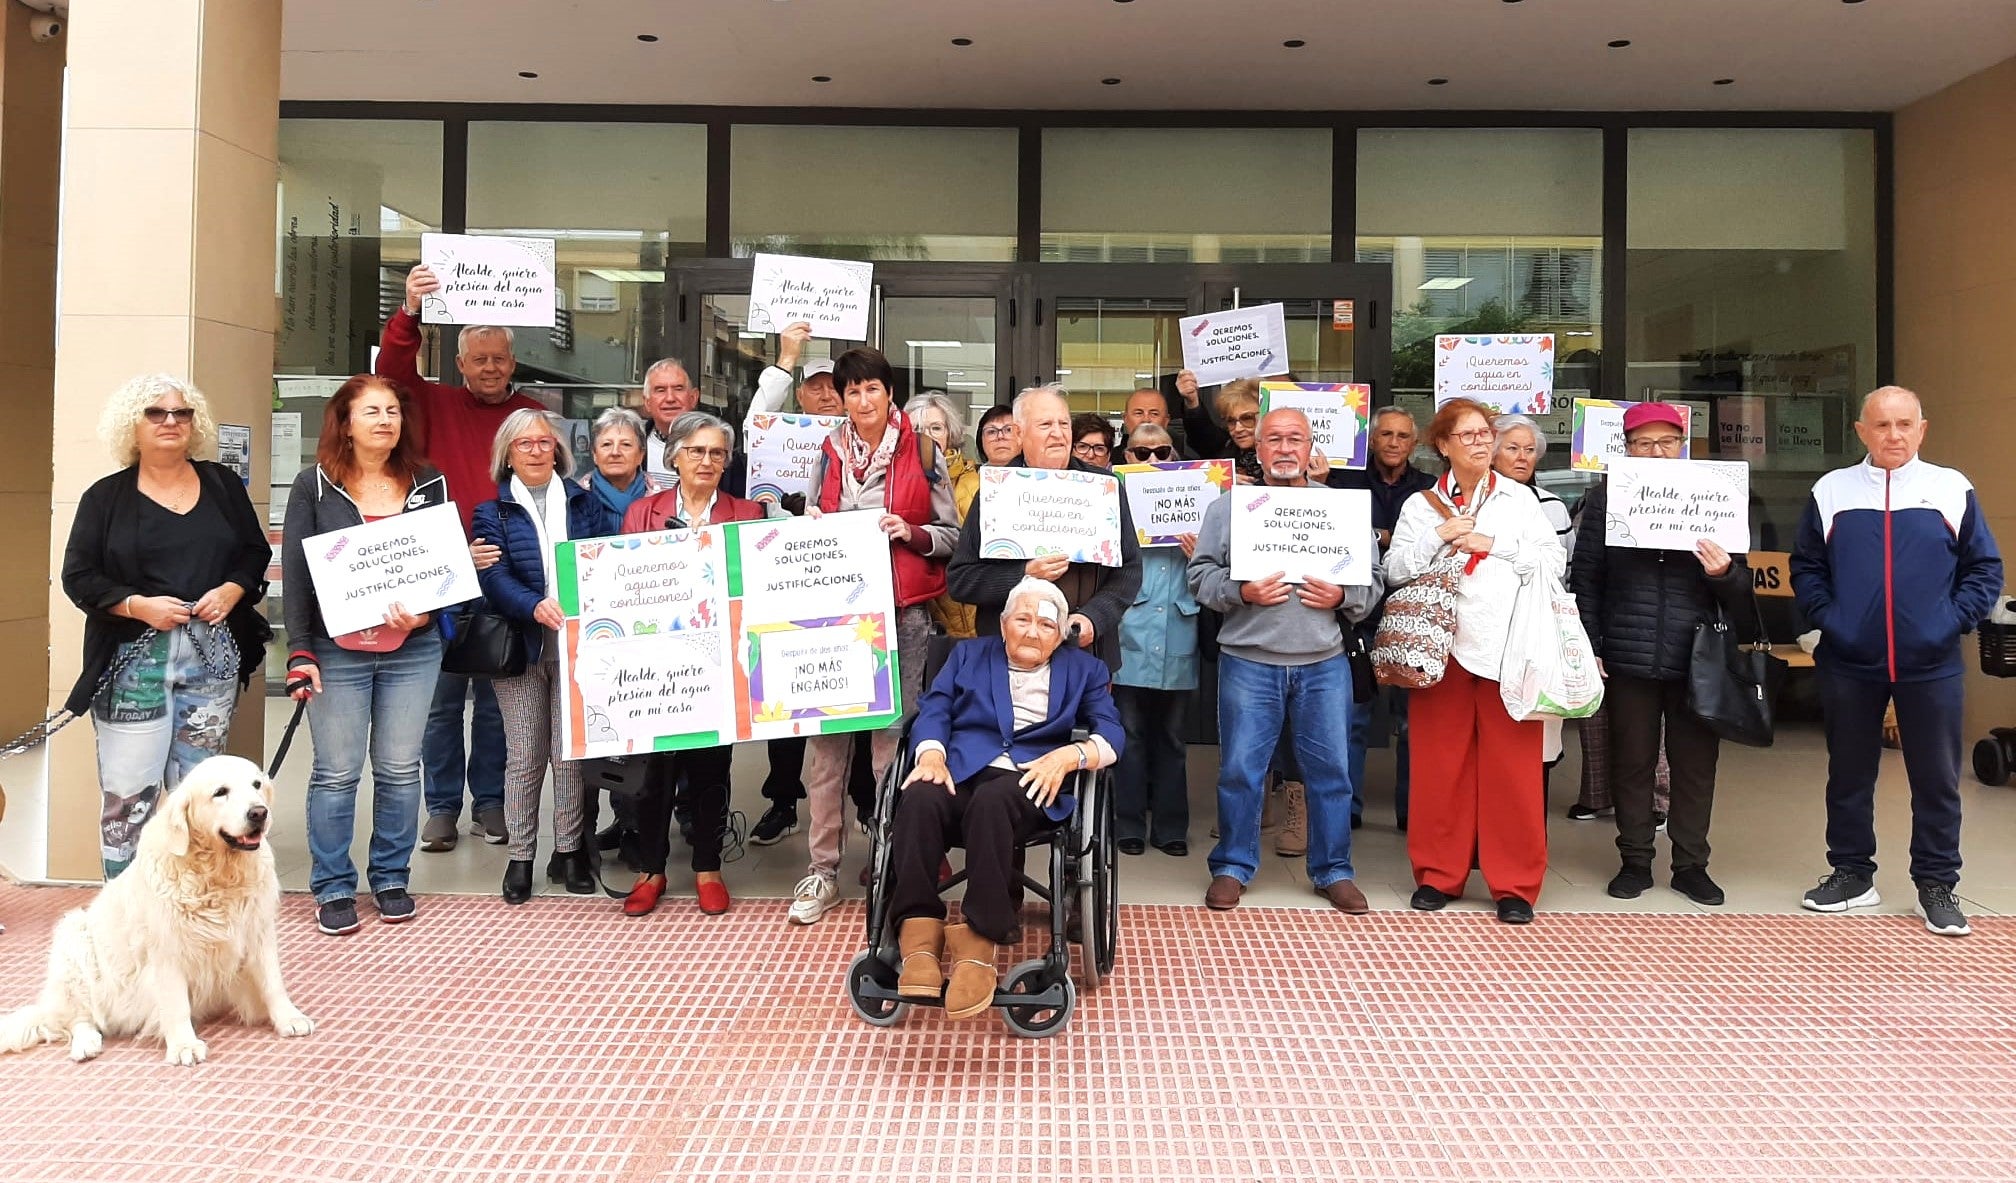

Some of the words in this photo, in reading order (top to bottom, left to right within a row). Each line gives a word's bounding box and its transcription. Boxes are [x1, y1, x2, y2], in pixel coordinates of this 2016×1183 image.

[451, 262, 496, 278] Alcalde,
[502, 267, 538, 281] quiero
[445, 280, 489, 294] presión
[493, 280, 511, 292] del
[515, 286, 543, 297] agua
[823, 286, 855, 298] quiero
[465, 299, 477, 307] en
[483, 296, 496, 307] mi
[501, 299, 525, 308] casa
[770, 294, 809, 306] presión
[814, 296, 830, 307] del
[833, 302, 858, 312] agua
[802, 310, 816, 319] mi
[820, 313, 840, 322] casa
[1213, 324, 1253, 336] QEREMOS
[1228, 344, 1241, 352] NO
[1200, 348, 1272, 365] JUSTIFICACIONES
[1466, 355, 1529, 368] ¡Queremos
[1474, 371, 1505, 384] agua
[1506, 371, 1521, 379] en
[1460, 381, 1532, 391] condiciones!
[1312, 416, 1331, 430] MÁS
[1736, 424, 1750, 432] no
[1794, 425, 1808, 433] no
[1312, 430, 1334, 444] ÑOS!
[1721, 435, 1732, 443] se
[1735, 433, 1763, 444] lleva
[1793, 435, 1821, 446] lleva
[1606, 444, 1625, 454] ENG
[792, 456, 813, 469] agu
[776, 465, 809, 478] condi
[1018, 492, 1092, 507] ¡Queremos
[1634, 486, 1683, 501] Alcalde,
[1690, 490, 1730, 503] quiero
[1155, 499, 1171, 511] ¡NO
[1175, 495, 1195, 508] MÁS
[1029, 509, 1065, 522] agua
[1067, 511, 1084, 520] en
[1151, 509, 1200, 524] ENGAÑOS!
[1275, 508, 1327, 518] QEREMOS
[1629, 504, 1675, 516] presión
[1681, 504, 1699, 516] del
[1705, 510, 1736, 521] agua
[1012, 522, 1096, 536] condiciones!
[1650, 522, 1663, 530] en
[1669, 520, 1683, 531] mi
[1690, 522, 1716, 533] casa
[1292, 533, 1309, 541] NO
[357, 535, 417, 556] QEREMOS
[784, 538, 838, 551] QEREMOS
[1253, 544, 1349, 555] JUSTIFICACIONES
[385, 565, 404, 575] NO
[614, 560, 688, 580] ¡Queremos
[804, 565, 822, 574] NO
[345, 564, 451, 601] JUSTIFICACIONES
[766, 573, 863, 591] JUSTIFICACIONES
[1755, 566, 1780, 589] AS
[624, 580, 660, 596] agua
[662, 577, 679, 587] en
[610, 589, 693, 609] condiciones!
[795, 663, 815, 678] ¡NO
[819, 657, 843, 673] MÁS
[612, 667, 659, 687] Alcalde,
[667, 665, 704, 682] quiero
[791, 676, 849, 694] ENGAÑOS!
[608, 687, 652, 706] presión
[658, 682, 676, 697] del
[681, 684, 711, 698] agua
[629, 710, 641, 718] en
[648, 703, 662, 715] mi
[667, 702, 694, 714] casa
